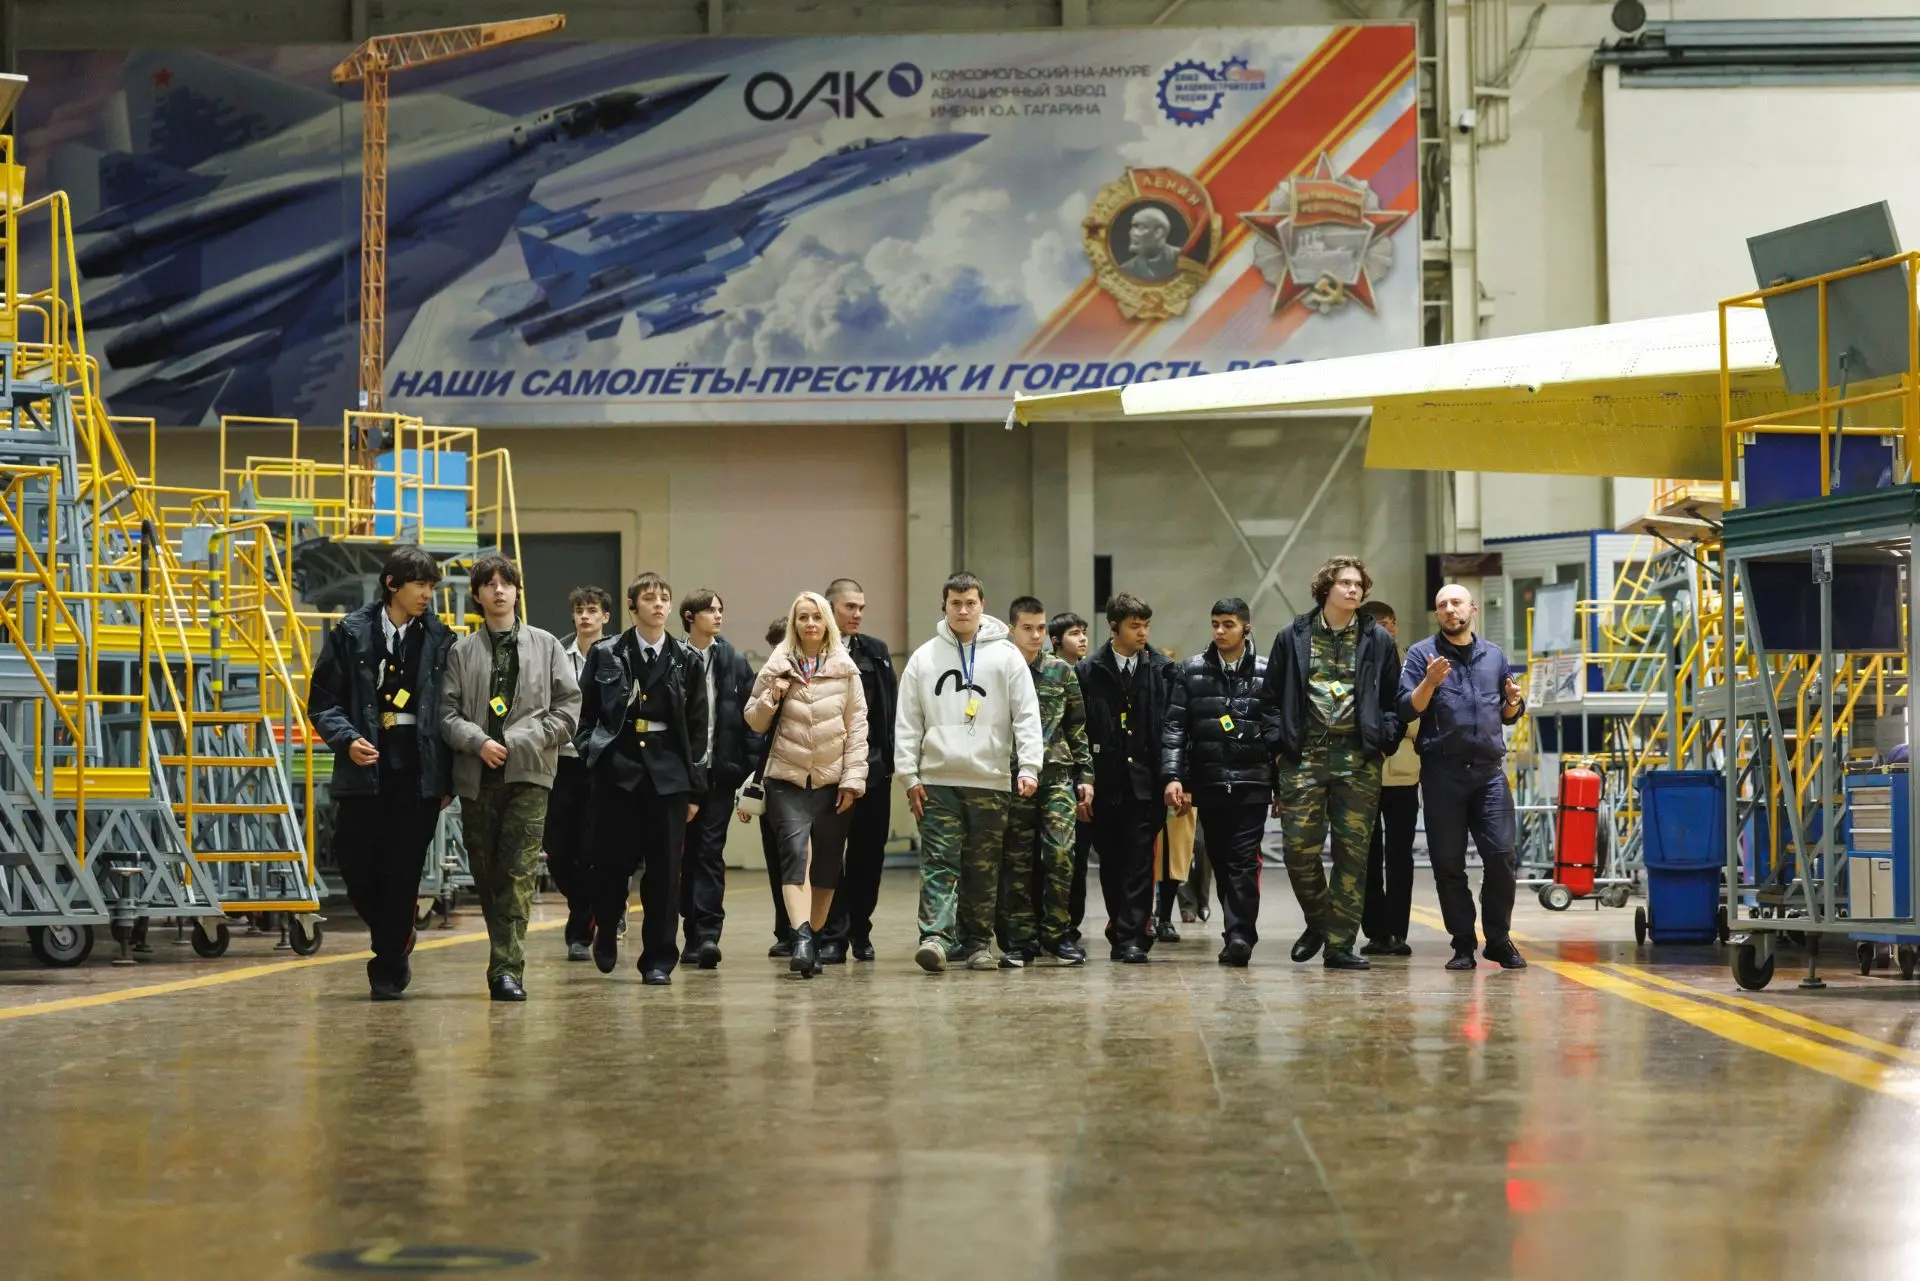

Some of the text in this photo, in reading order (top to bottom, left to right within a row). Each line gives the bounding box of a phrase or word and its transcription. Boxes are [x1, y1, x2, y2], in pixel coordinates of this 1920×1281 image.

[931, 64, 1151, 82] КОМСОМОЛЬСКИЙ-НА-АМУРЕ
[743, 70, 884, 121] ОАК
[931, 83, 1107, 100] АВИАЦИОННЫЙ ЗАВОД
[930, 104, 985, 118] ИМЕНИ
[1024, 102, 1101, 117] ГАГАРИНА
[1143, 176, 1200, 206] ЛЕНИН
[389, 369, 516, 397] НАШИ
[959, 364, 992, 391] И
